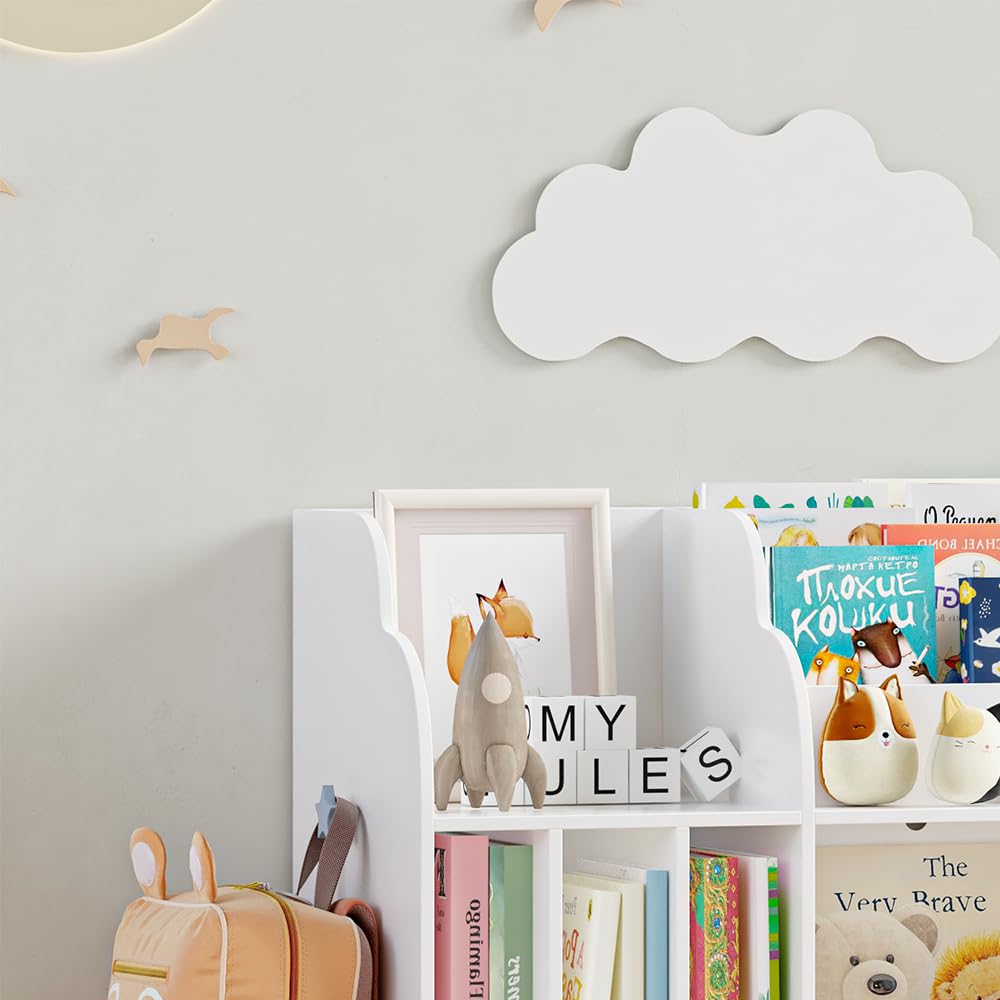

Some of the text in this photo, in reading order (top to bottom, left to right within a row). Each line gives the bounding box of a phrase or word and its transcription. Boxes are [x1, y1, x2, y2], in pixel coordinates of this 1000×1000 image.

[526, 703, 628, 743] MY
[922, 854, 969, 878] The
[833, 891, 898, 913] Very
